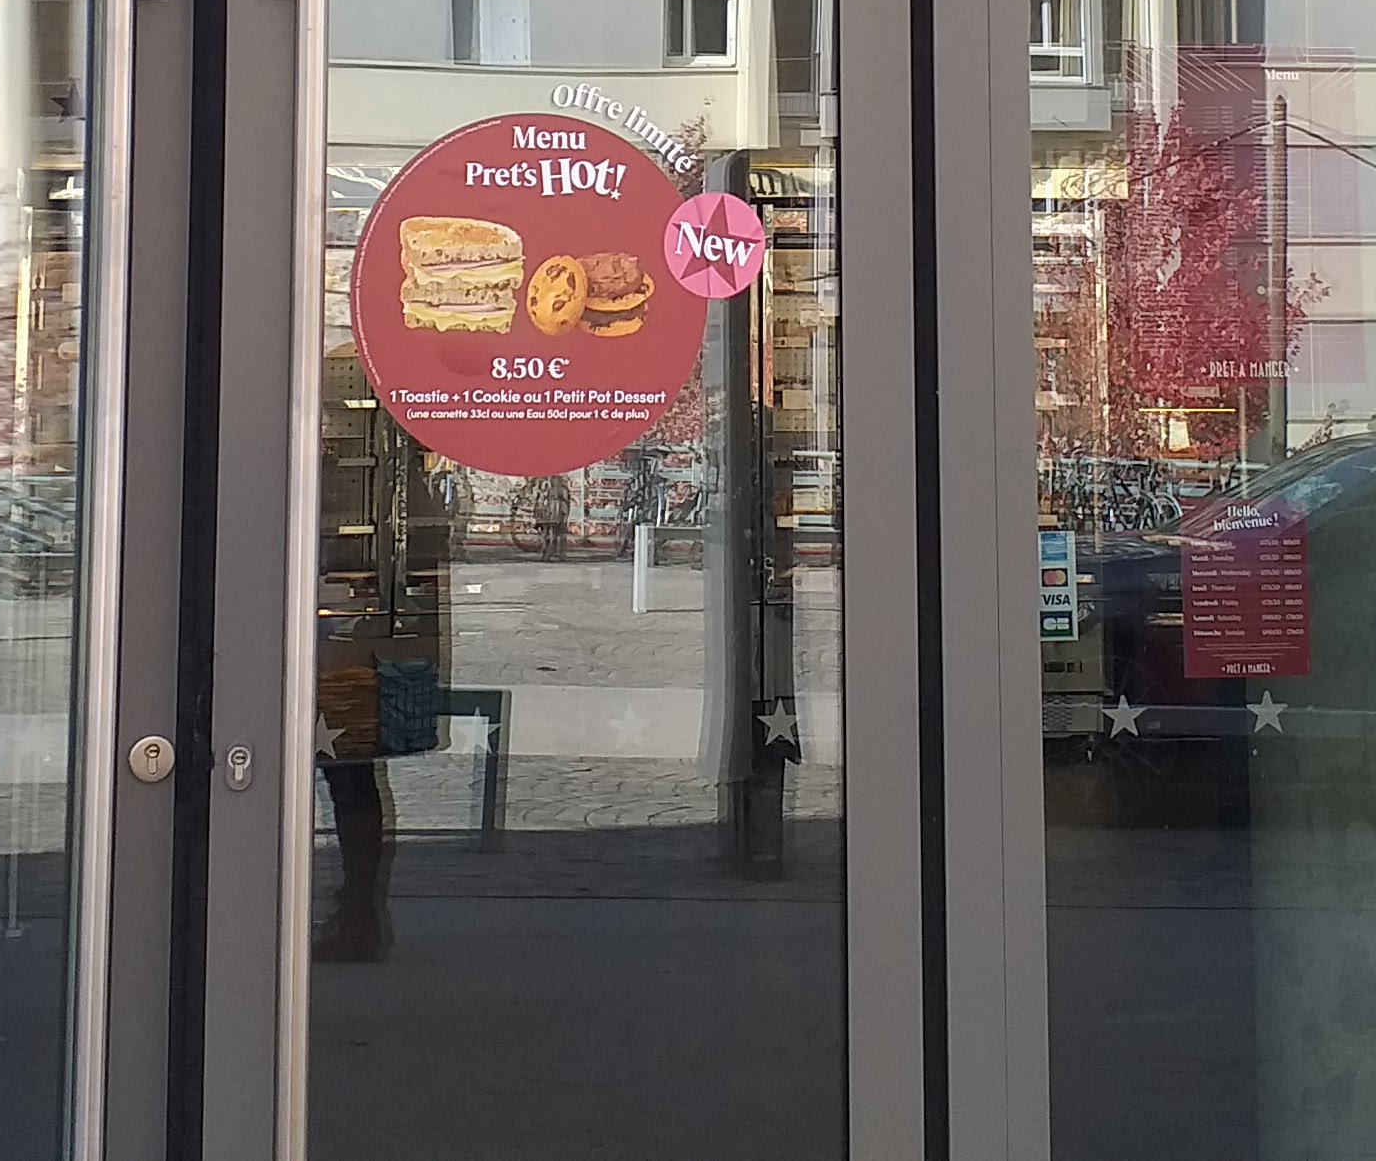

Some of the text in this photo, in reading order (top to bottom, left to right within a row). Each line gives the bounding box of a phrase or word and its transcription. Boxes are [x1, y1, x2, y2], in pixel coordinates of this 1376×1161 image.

[512, 125, 587, 150] Menu
[552, 82, 698, 174] Offre limité
[465, 161, 538, 187] Pret's
[538, 156, 628, 201] Hot!
[675, 220, 756, 268] New
[491, 357, 545, 381] 8,50
[1209, 359, 1291, 378] PRET A MANGER
[389, 391, 397, 403] 1
[399, 389, 449, 404] Toastie
[463, 391, 470, 403] 1
[473, 389, 520, 404] Cookie
[523, 392, 542, 404] ou
[544, 391, 550, 403] 1
[554, 389, 586, 404] Petit
[589, 389, 612, 404] Pot
[614, 389, 666, 404] Dessert
[406, 408, 429, 420] (une
[431, 408, 469, 419] canette
[470, 409, 490, 419] 33cl
[491, 410, 505, 419] ou
[506, 410, 525, 419] une
[526, 409, 546, 419] Eau
[547, 409, 568, 419] 50cl
[569, 410, 592, 421] pour
[610, 409, 624, 419] de
[625, 408, 650, 421] plus)
[1226, 504, 1261, 518] Hello,
[1213, 512, 1279, 532] bienvenue!
[1041, 594, 1071, 606] VISA
